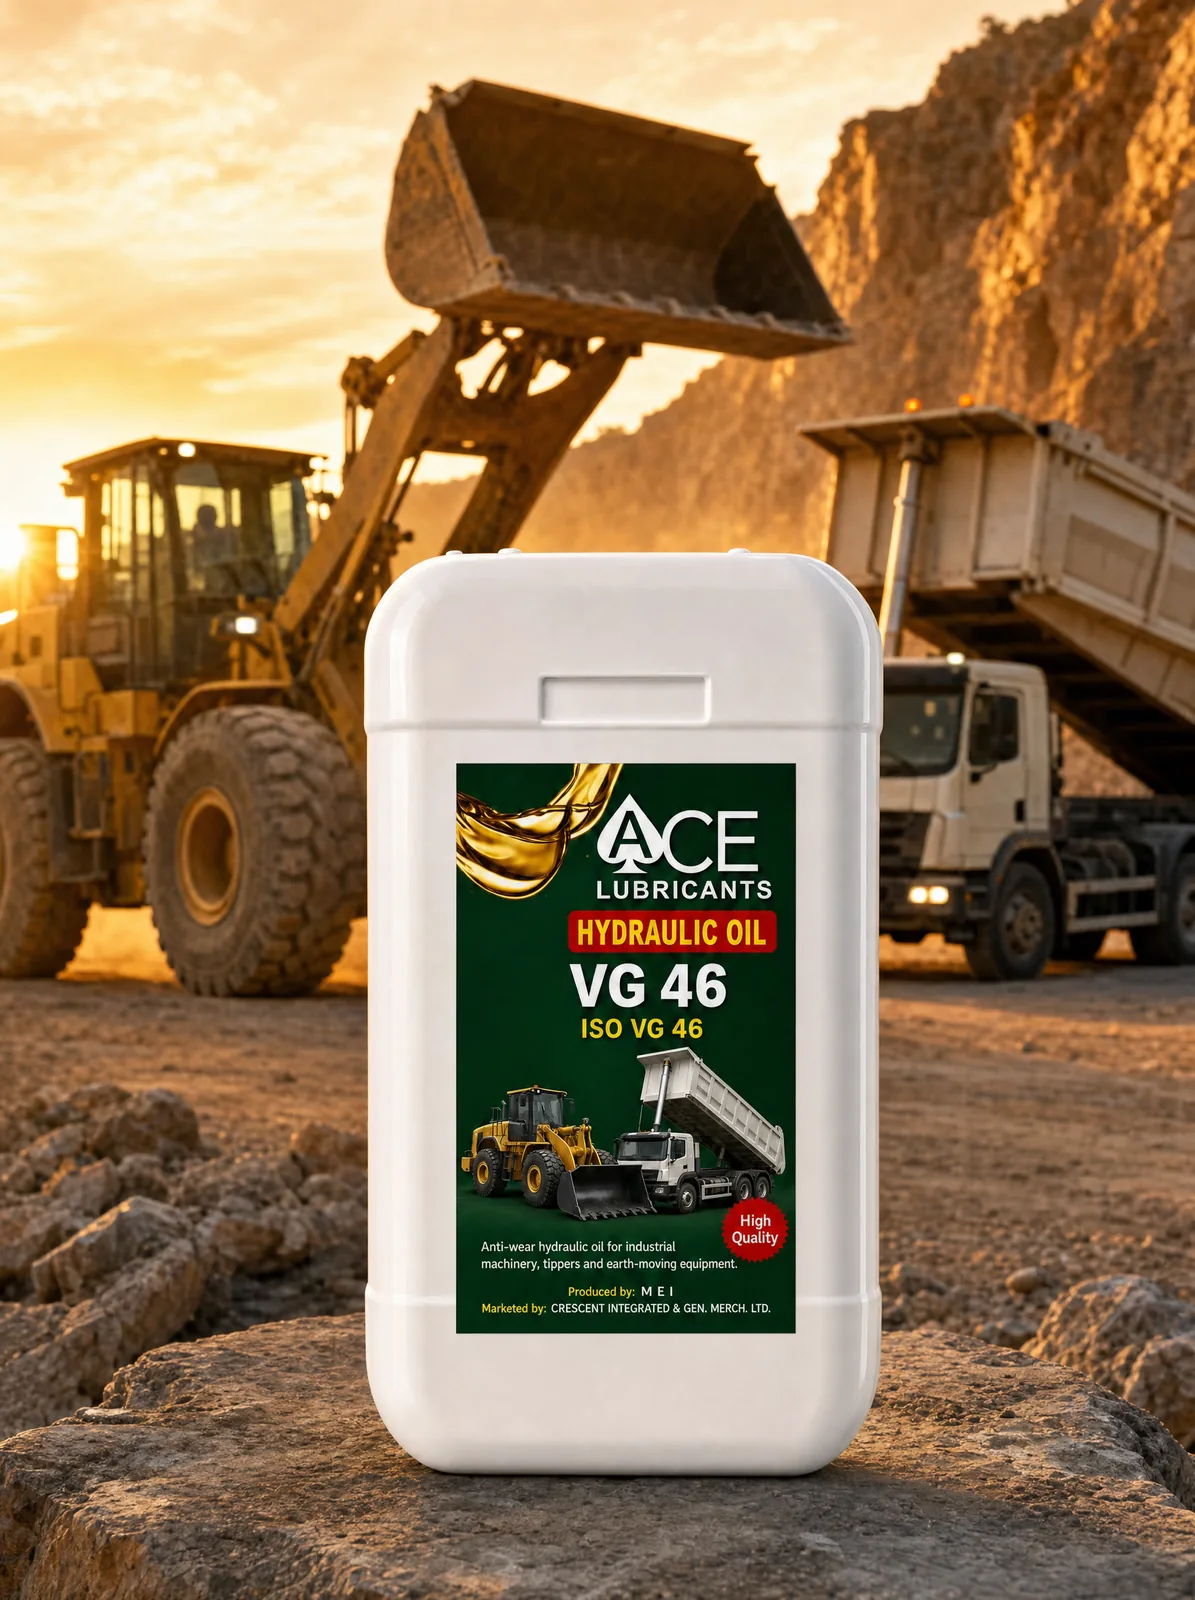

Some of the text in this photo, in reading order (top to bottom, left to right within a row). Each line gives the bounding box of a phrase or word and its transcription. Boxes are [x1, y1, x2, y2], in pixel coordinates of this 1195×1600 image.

[597, 793, 758, 873] ACE
[597, 880, 771, 899] LUBRICANTS
[578, 919, 766, 945] HYDRAULIC OIL
[570, 963, 726, 1007] VG 46
[582, 1018, 702, 1038] ISO VG 46
[740, 1214, 771, 1229] High
[731, 1231, 779, 1247] Quality
[480, 1240, 676, 1255] Anti-wear hydraulic oil for industrial
[481, 1258, 738, 1272] machinery, tippers and earth-moving equipment.
[568, 1286, 617, 1297] Produced
[619, 1286, 636, 1300] by:
[481, 1303, 771, 1316] Marketed by: CRESCENT INTEGRATED & GEN. MERCH. LTD.
